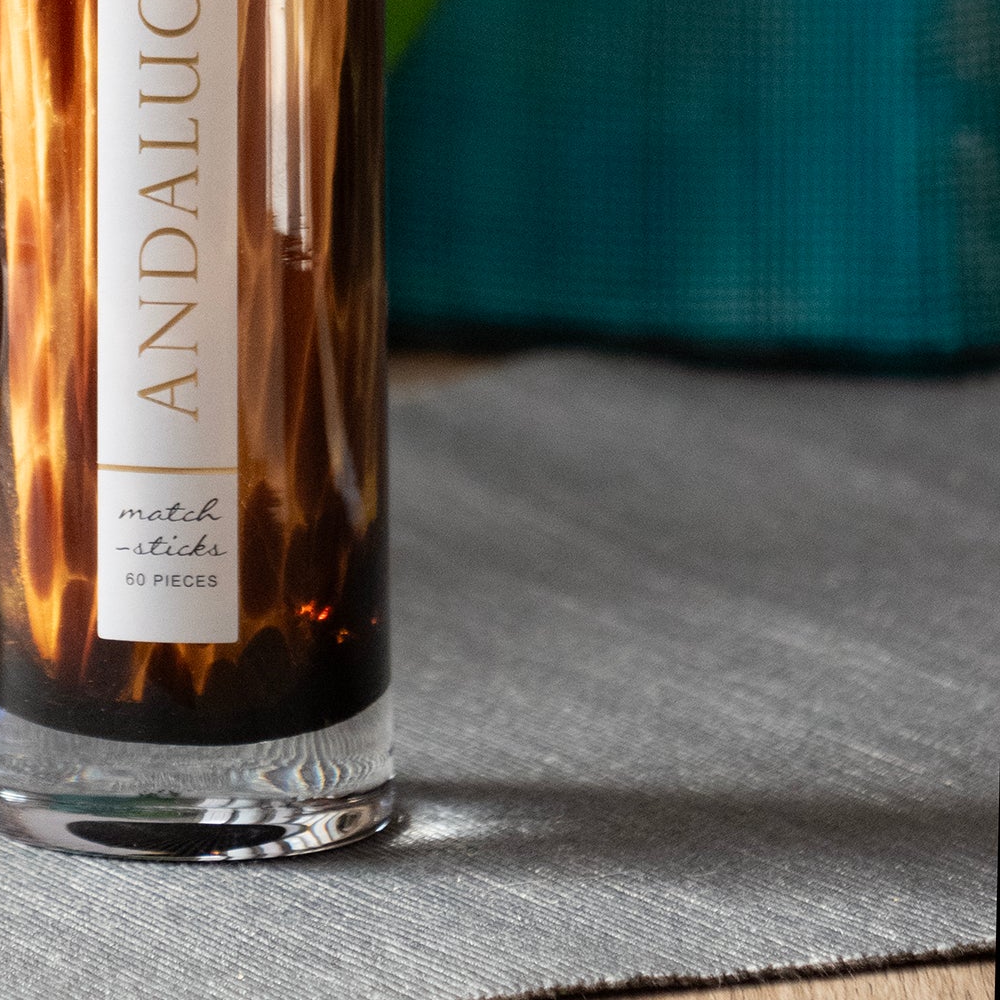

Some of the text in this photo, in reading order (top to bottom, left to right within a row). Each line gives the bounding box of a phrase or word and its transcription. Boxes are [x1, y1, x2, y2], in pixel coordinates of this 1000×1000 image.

[118, 498, 223, 522] match
[115, 534, 228, 556] -sticks
[125, 572, 218, 588] 60 PIECES
